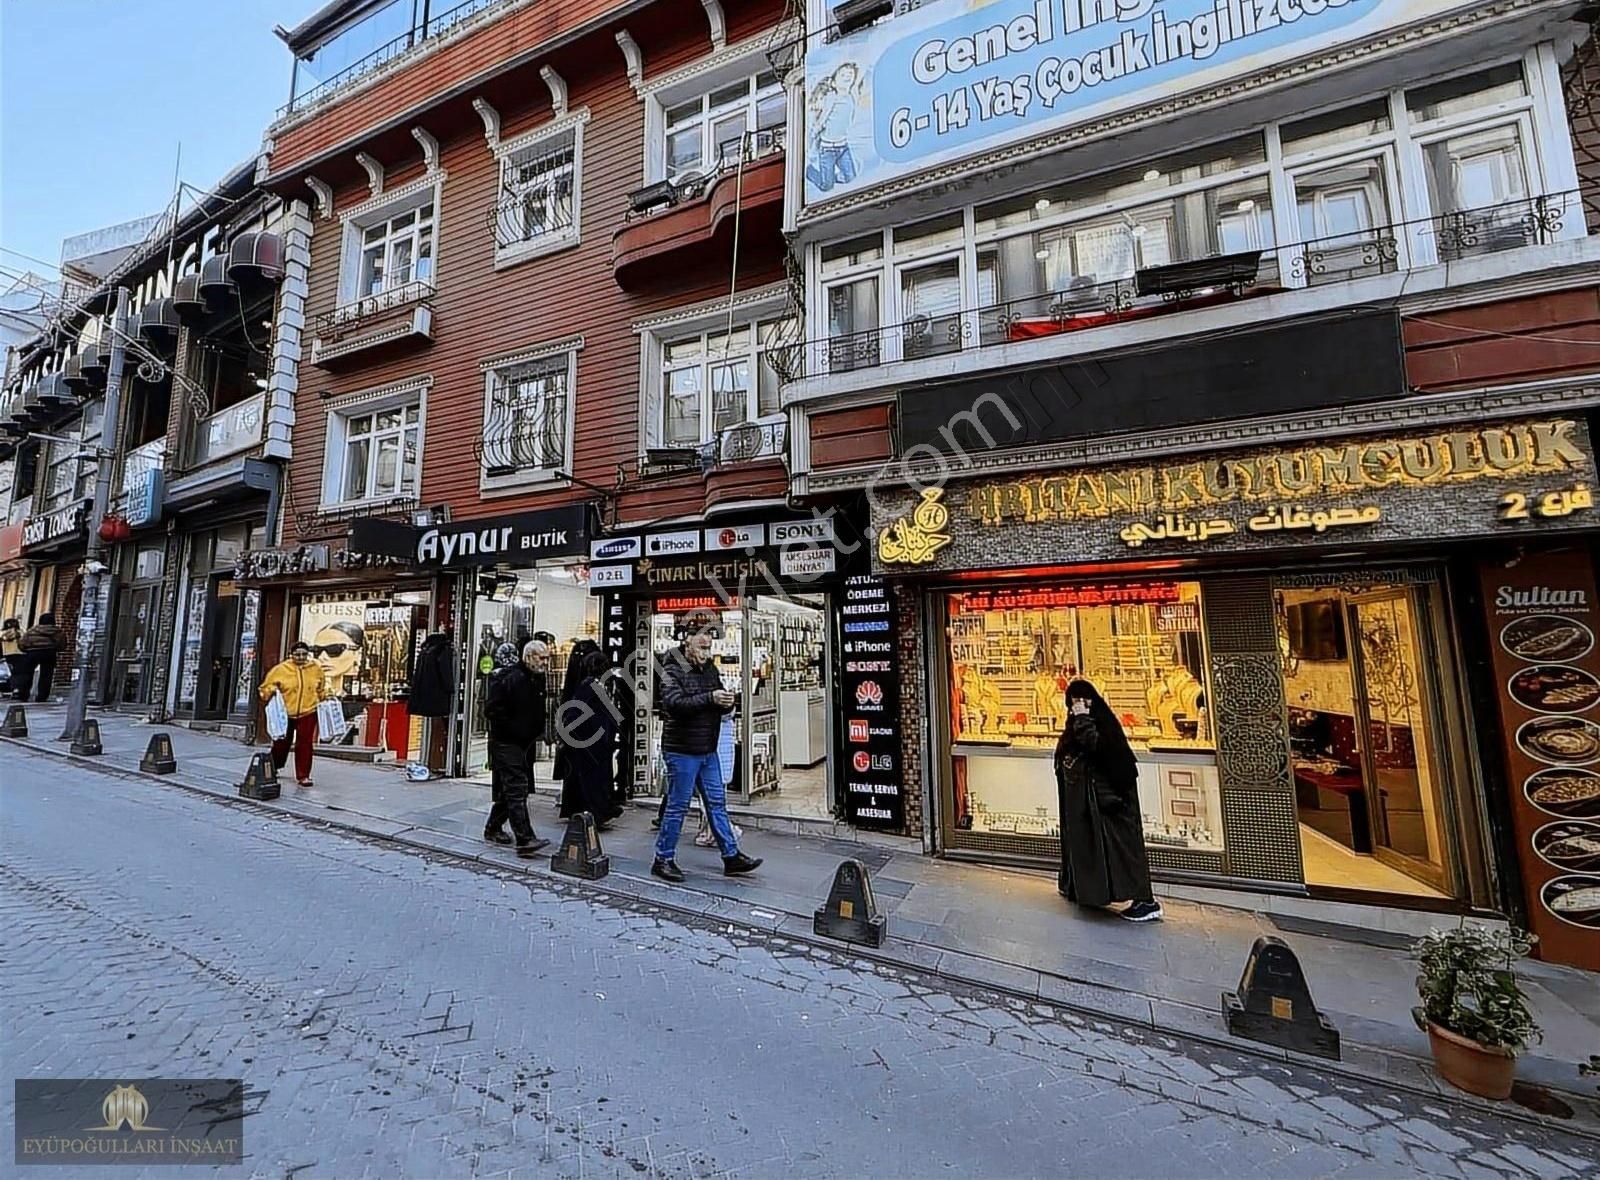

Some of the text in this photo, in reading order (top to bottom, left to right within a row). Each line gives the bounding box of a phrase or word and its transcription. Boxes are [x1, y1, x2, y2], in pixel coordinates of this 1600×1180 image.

[912, 0, 1053, 84] Genel
[972, 77, 1032, 117] Yaş
[1035, 29, 1150, 108] Çocuk
[1502, 483, 1592, 519] فرع 2
[775, 524, 825, 541] SONY
[417, 525, 513, 566] Aynur
[520, 528, 568, 549] BUTİK
[661, 538, 695, 551] iPhone
[647, 563, 696, 585] ÇINAR
[845, 575, 883, 585] ATU
[847, 588, 885, 600] ÖDEME
[1495, 586, 1587, 607] Sultan
[308, 604, 363, 616] GUESS
[843, 601, 890, 615] MERKEZİ
[609, 592, 624, 678] EKNİK
[855, 640, 891, 652] iPhone
